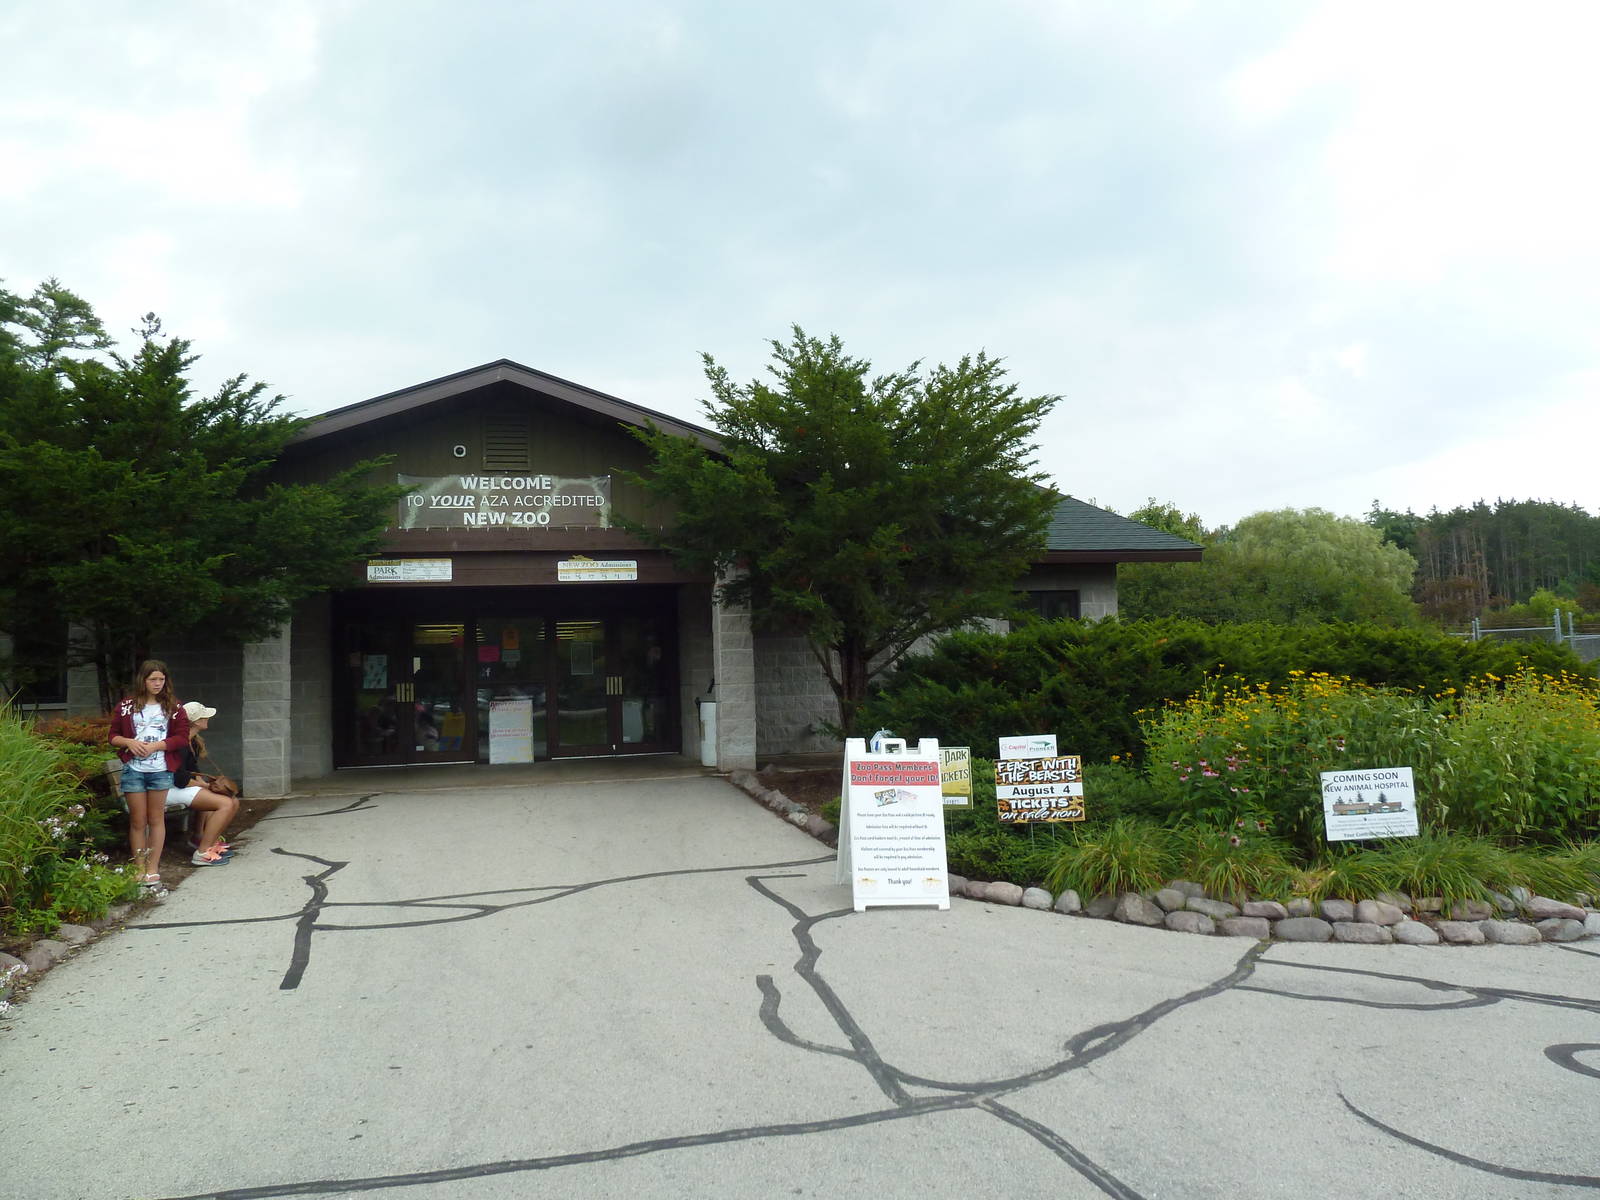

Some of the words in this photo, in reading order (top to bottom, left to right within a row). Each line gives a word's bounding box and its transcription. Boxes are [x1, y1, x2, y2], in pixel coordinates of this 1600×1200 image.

[461, 477, 552, 490] WELCOME
[407, 496, 424, 507] TO
[428, 496, 475, 509] YOUR
[480, 496, 509, 507] AZA
[514, 496, 605, 507] ACCREDITED
[463, 512, 506, 525] NEW
[512, 511, 551, 525] ZOO
[374, 566, 398, 576] PARK
[944, 750, 967, 767] PARK
[856, 763, 872, 771] Zoo
[874, 763, 893, 771] Pass
[895, 763, 933, 771] Members
[998, 760, 1041, 774] FEAST
[1041, 758, 1077, 771] WITH
[851, 774, 873, 782] Don't
[875, 774, 902, 784] forget
[905, 775, 925, 784] your
[941, 769, 969, 783] ICKETS
[1000, 771, 1025, 783] THE
[1029, 769, 1077, 782] BEASTS
[1333, 773, 1371, 783] COMING
[1373, 771, 1399, 781] SOON
[1012, 785, 1055, 797] August
[1063, 785, 1070, 794] 4
[1324, 785, 1341, 793] NEW
[1343, 782, 1373, 791] ANIMAL
[1374, 781, 1409, 790] HOSPITAL
[1009, 798, 1069, 809] TICKETS
[1001, 811, 1016, 820] on
[1020, 807, 1050, 819] sale
[1051, 809, 1081, 819] now
